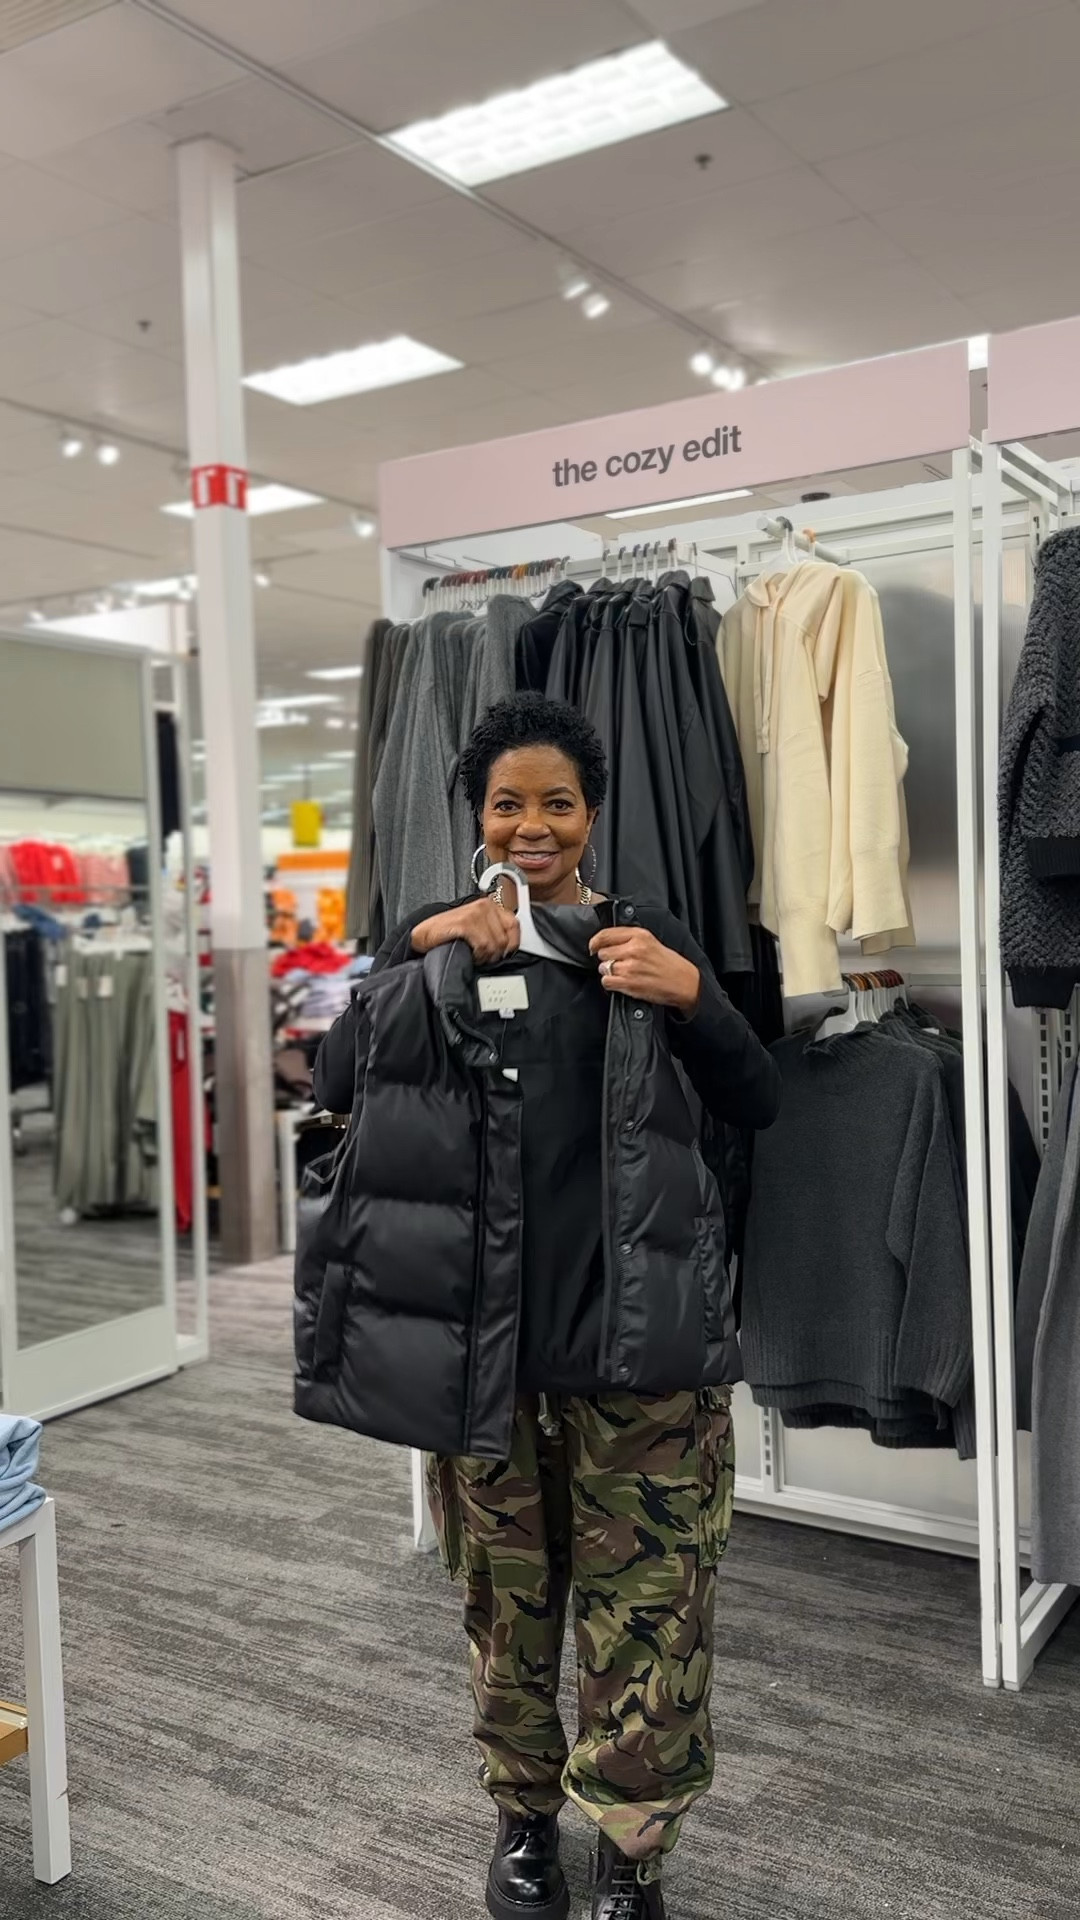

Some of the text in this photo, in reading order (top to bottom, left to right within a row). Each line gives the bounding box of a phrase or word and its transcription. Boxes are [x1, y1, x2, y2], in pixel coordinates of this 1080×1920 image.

[552, 425, 742, 487] the cozy edit
